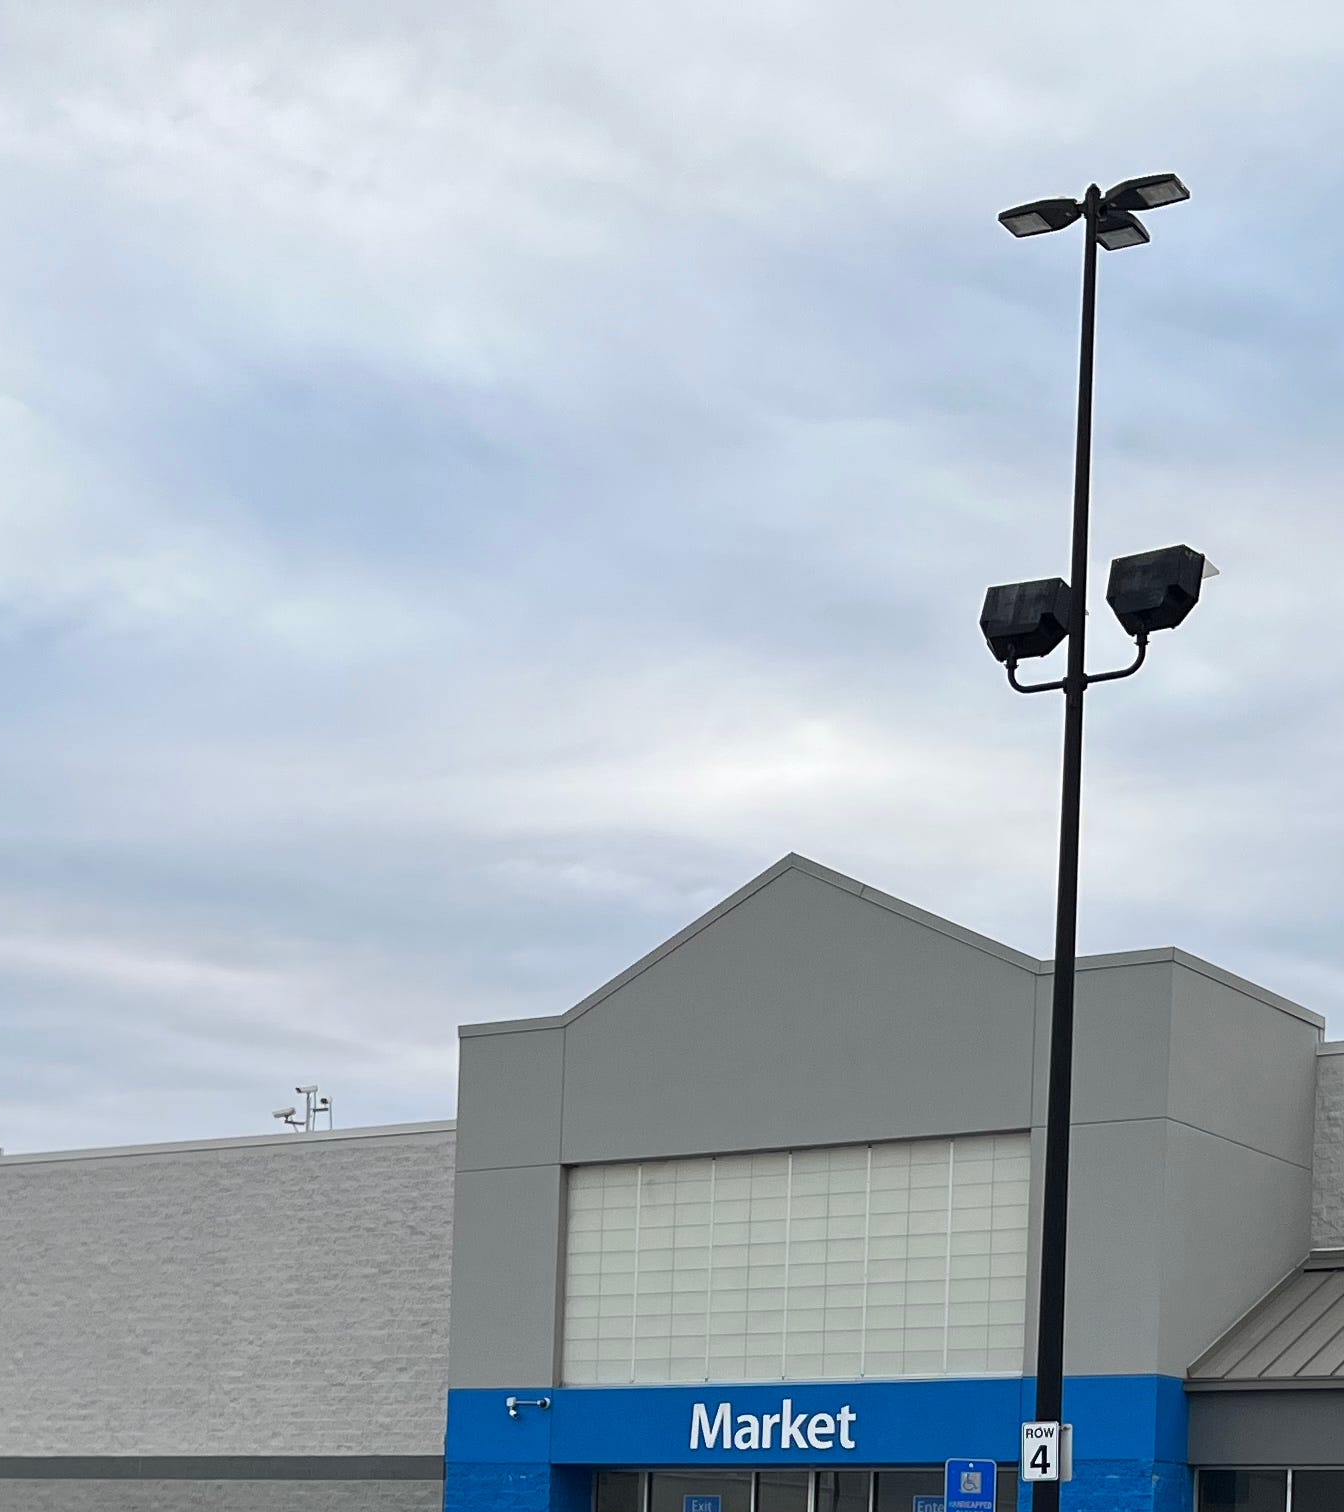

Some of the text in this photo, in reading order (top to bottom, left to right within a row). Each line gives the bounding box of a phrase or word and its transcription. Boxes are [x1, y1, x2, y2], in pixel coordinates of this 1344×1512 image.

[689, 1399, 856, 1450] Market
[1026, 1427, 1055, 1438] ROW
[1029, 1445, 1050, 1474] 4
[692, 1500, 712, 1512] Exit
